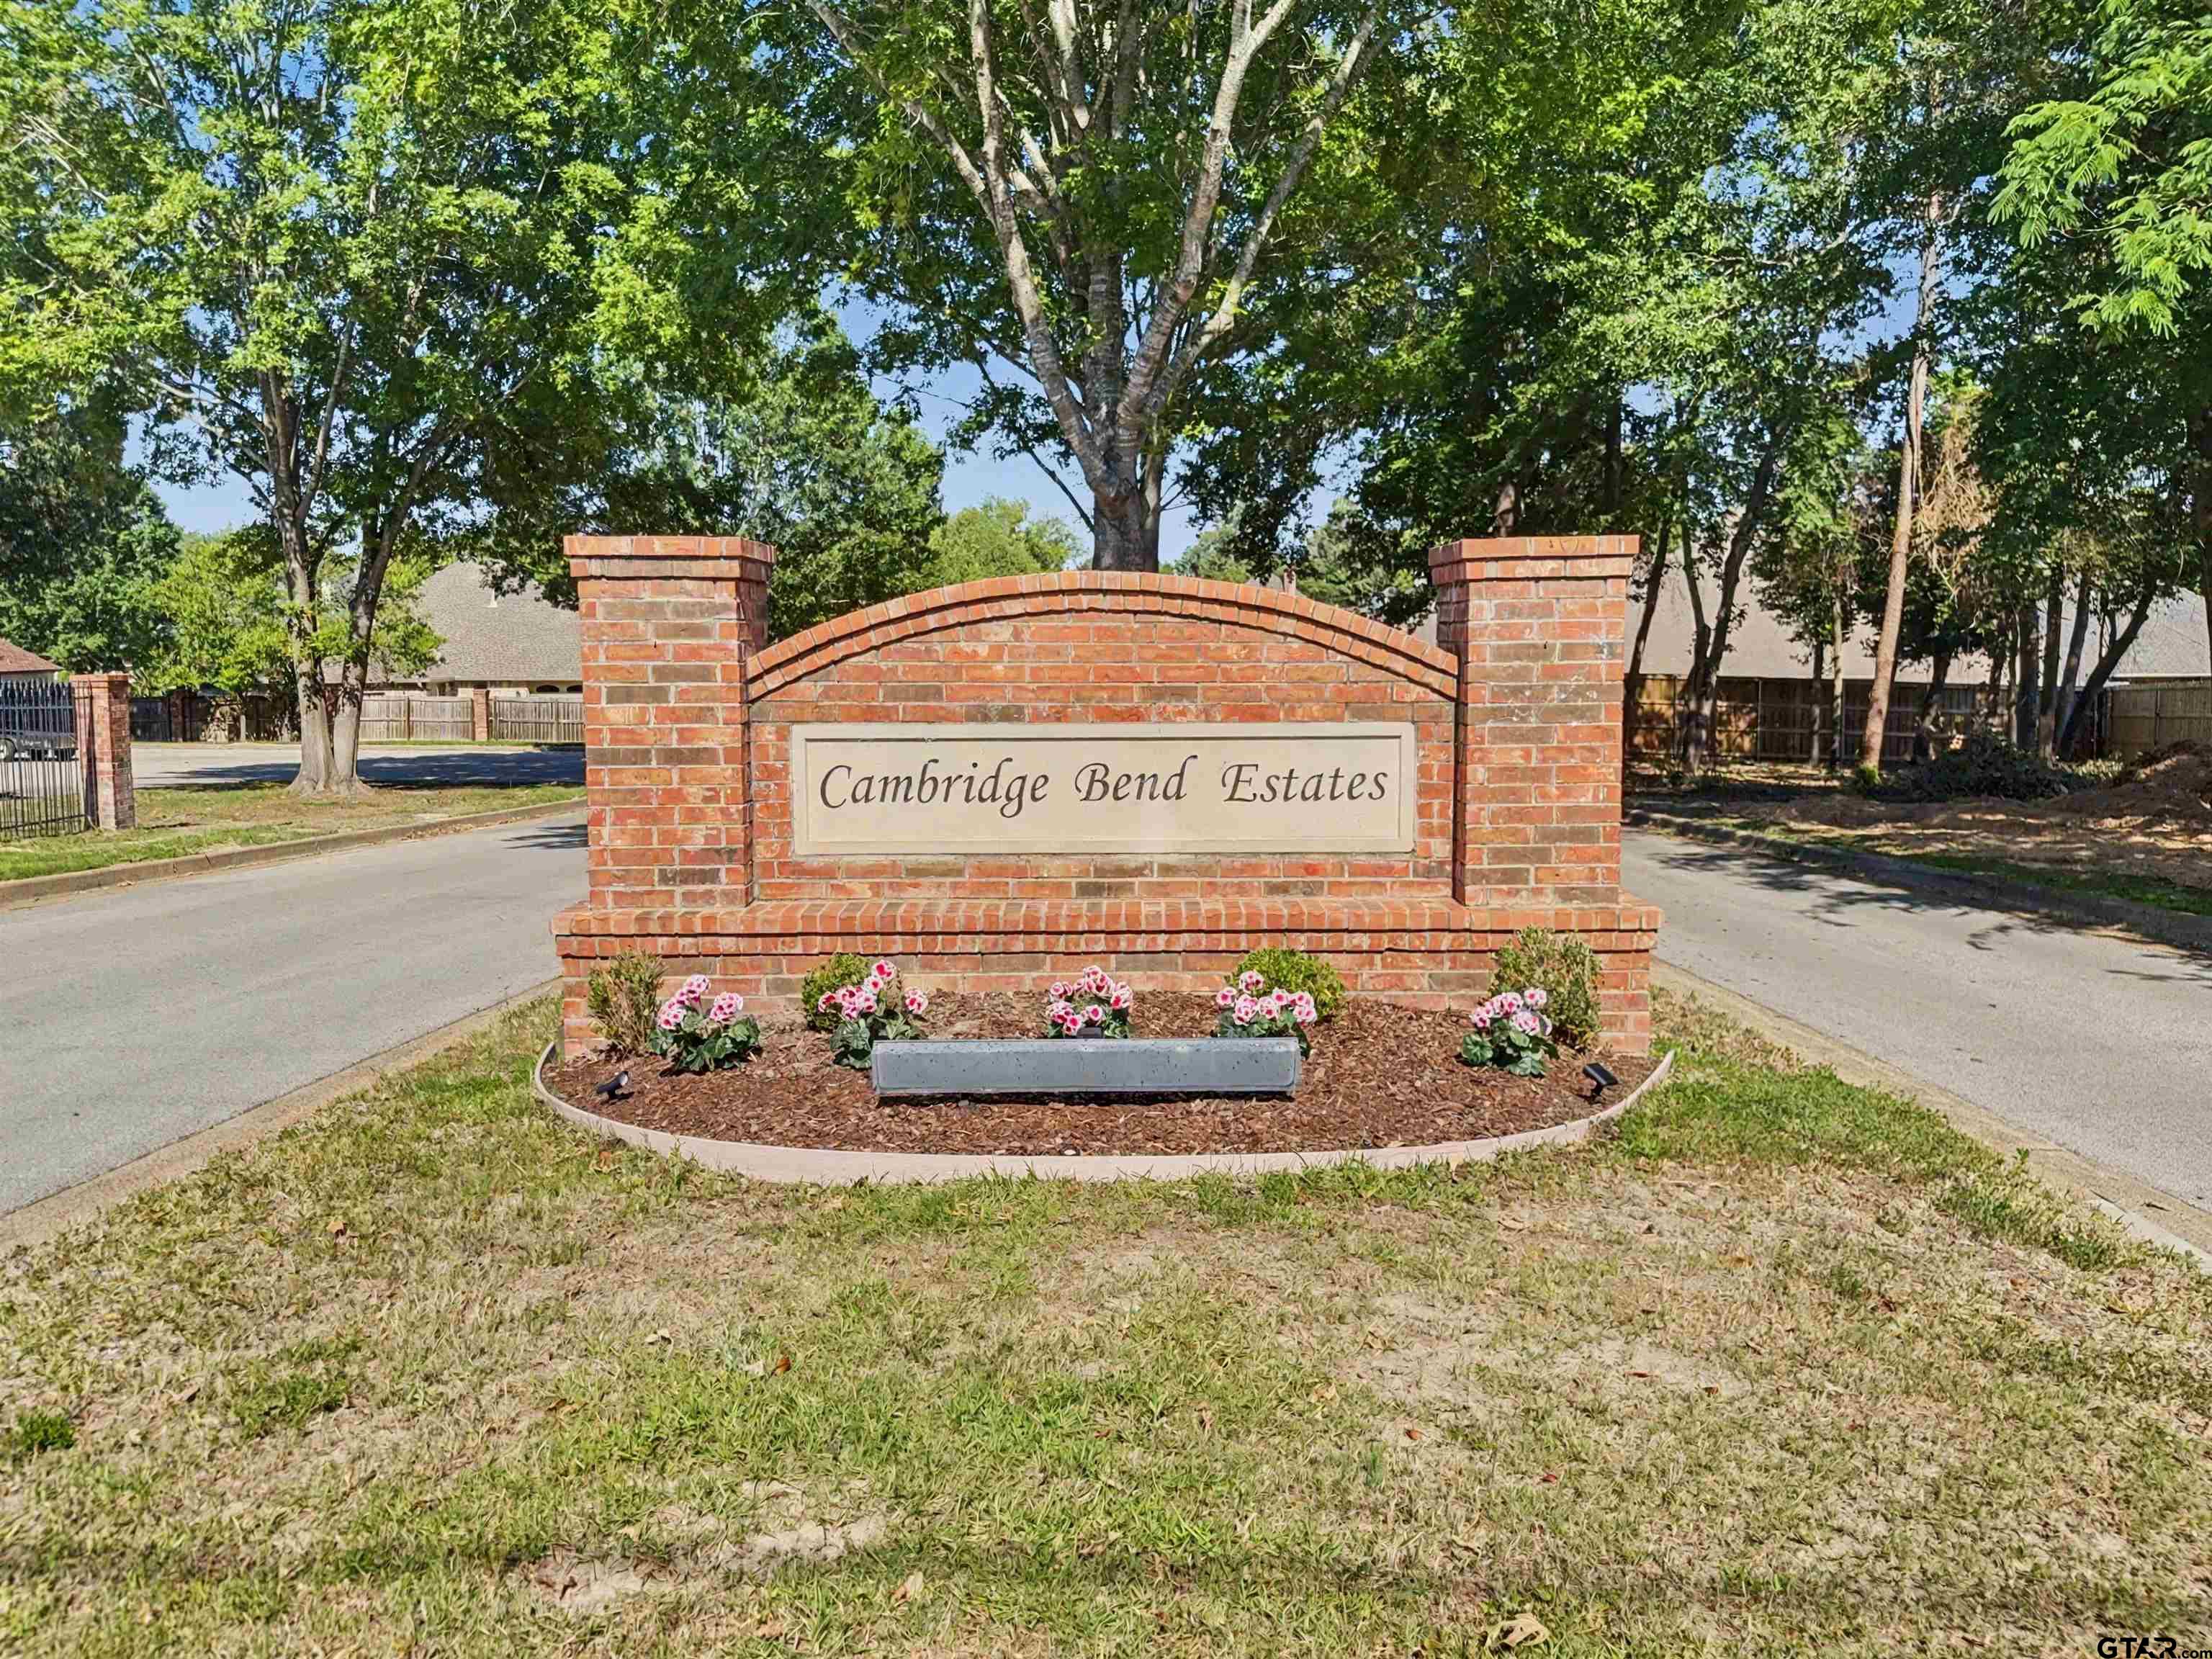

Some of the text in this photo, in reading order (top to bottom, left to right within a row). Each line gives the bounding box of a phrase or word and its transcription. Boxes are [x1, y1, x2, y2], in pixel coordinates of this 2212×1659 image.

[819, 755, 1388, 818] Cambridge Bend Estates
